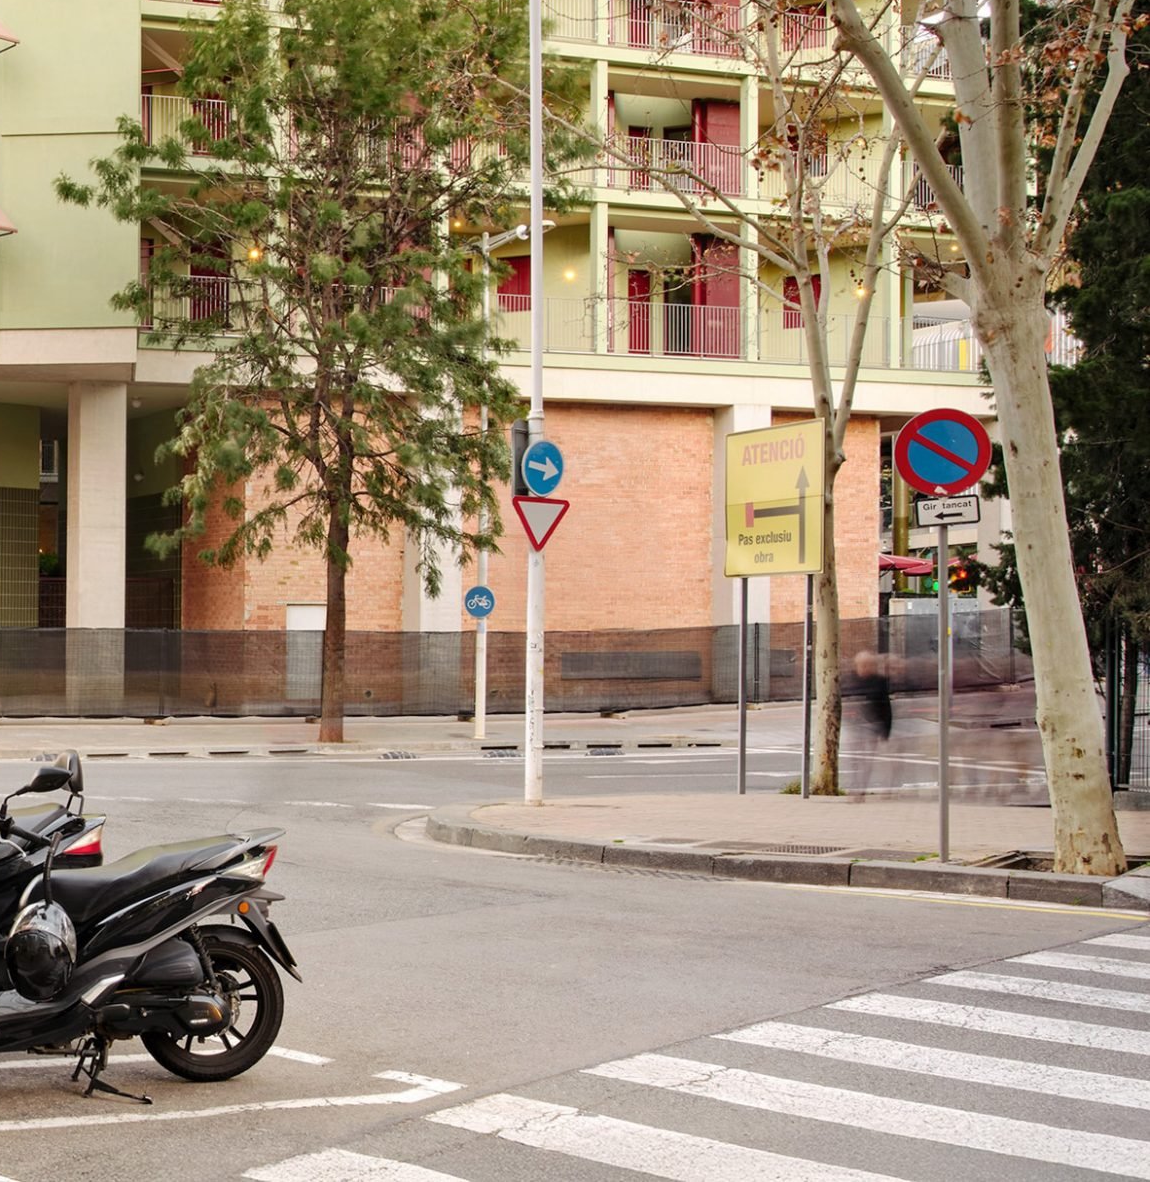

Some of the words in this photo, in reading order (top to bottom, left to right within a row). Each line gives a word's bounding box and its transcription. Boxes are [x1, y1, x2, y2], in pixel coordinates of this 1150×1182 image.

[742, 434, 805, 466] ATENCIÓ
[922, 503, 937, 511] Gir
[942, 500, 972, 509] tancat
[738, 533, 754, 546] Pas
[755, 530, 792, 545] exclusiu
[754, 551, 774, 563] obra
